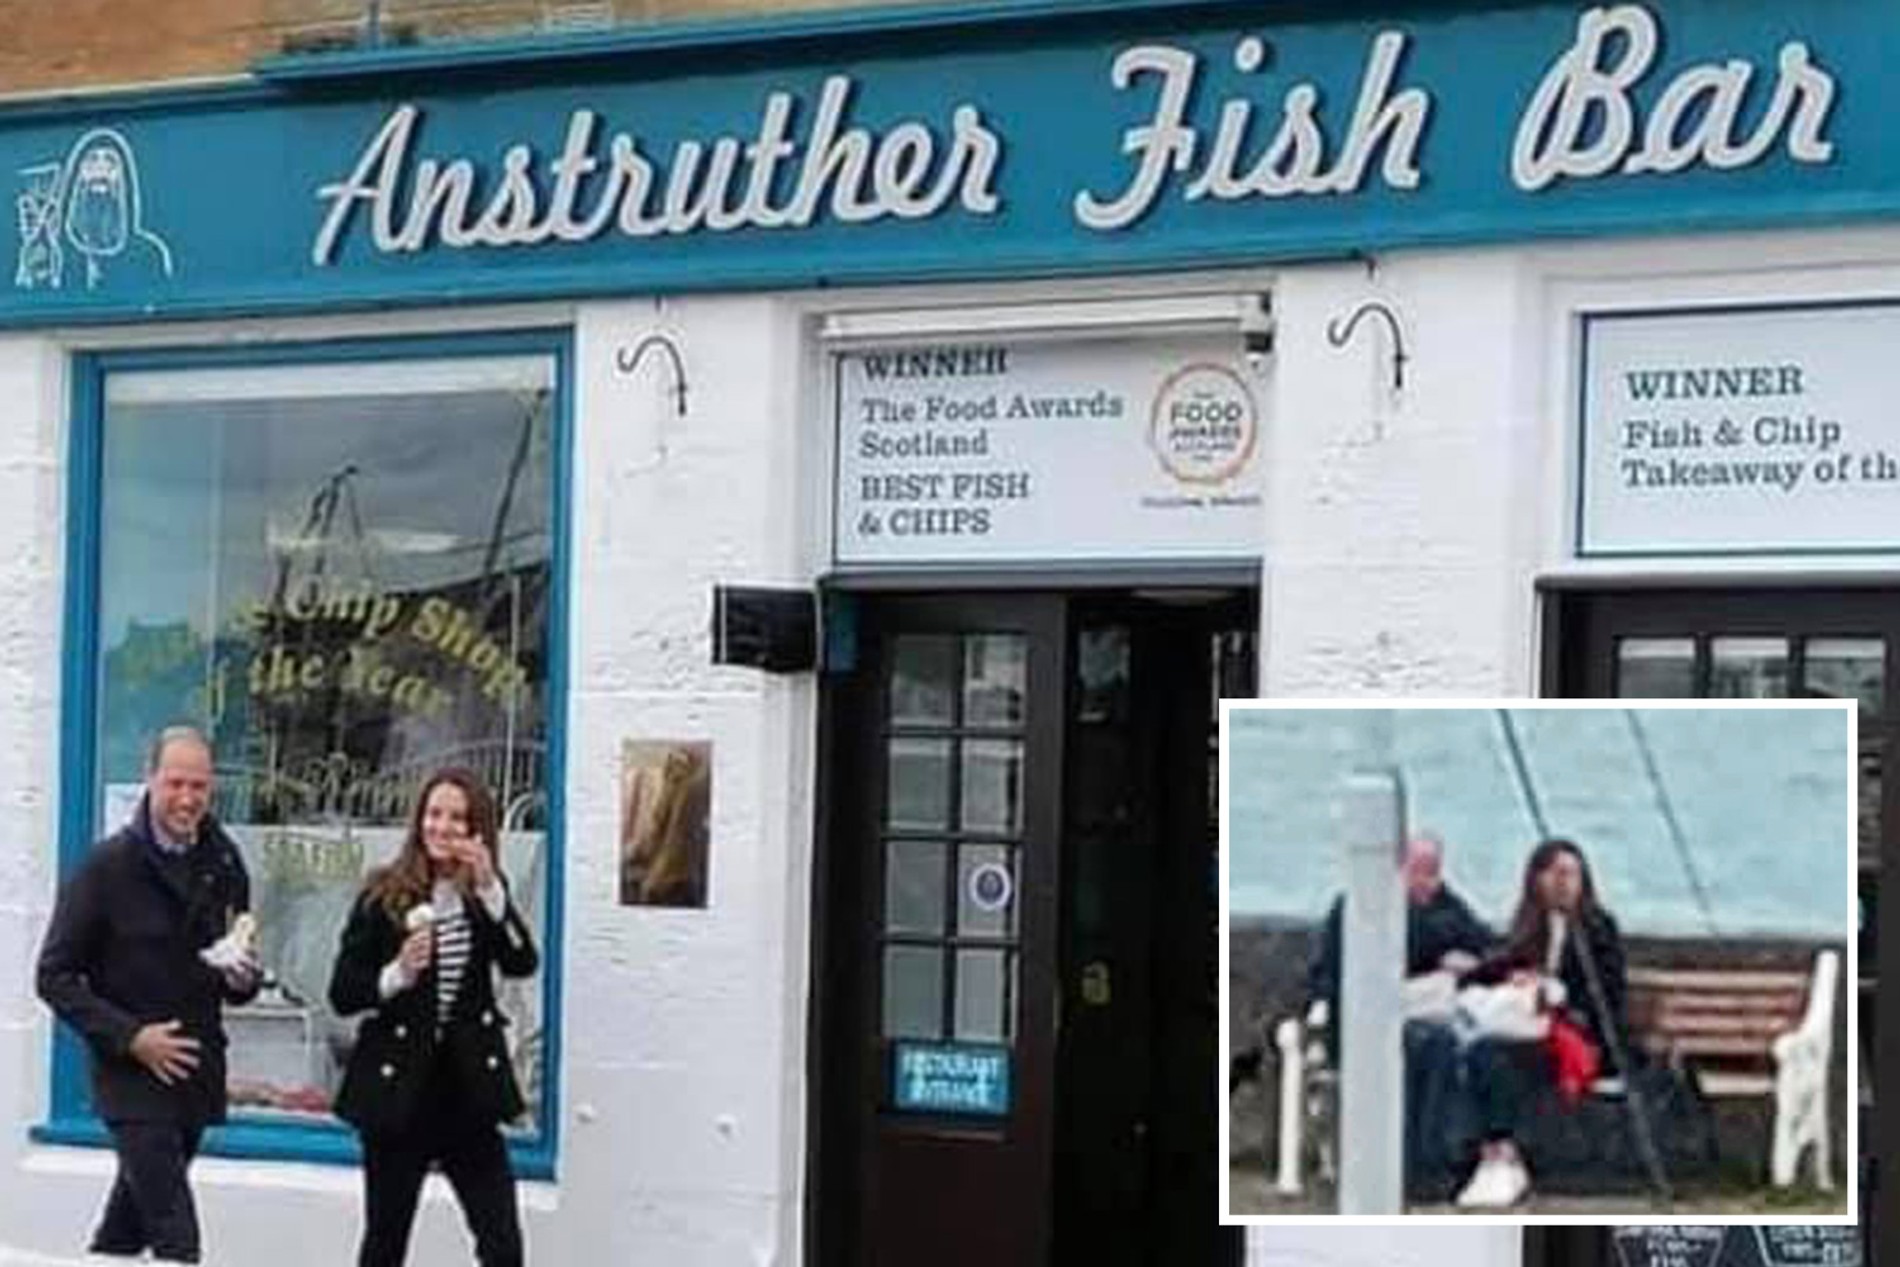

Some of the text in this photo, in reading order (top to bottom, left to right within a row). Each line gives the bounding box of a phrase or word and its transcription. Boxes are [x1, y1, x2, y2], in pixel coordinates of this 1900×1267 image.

[313, 4, 1834, 266] Anstruther Fish Bar
[1625, 364, 1805, 400] WINNER
[861, 389, 1124, 423] The Food Awards
[858, 428, 989, 459] Scotland
[1623, 414, 1842, 450] Fish & Chip
[861, 471, 1030, 500] BEST FISH
[1620, 457, 1804, 492] Takeaway
[1814, 453, 1853, 482] of
[857, 507, 992, 537] & CHIPS
[249, 643, 324, 696] the
